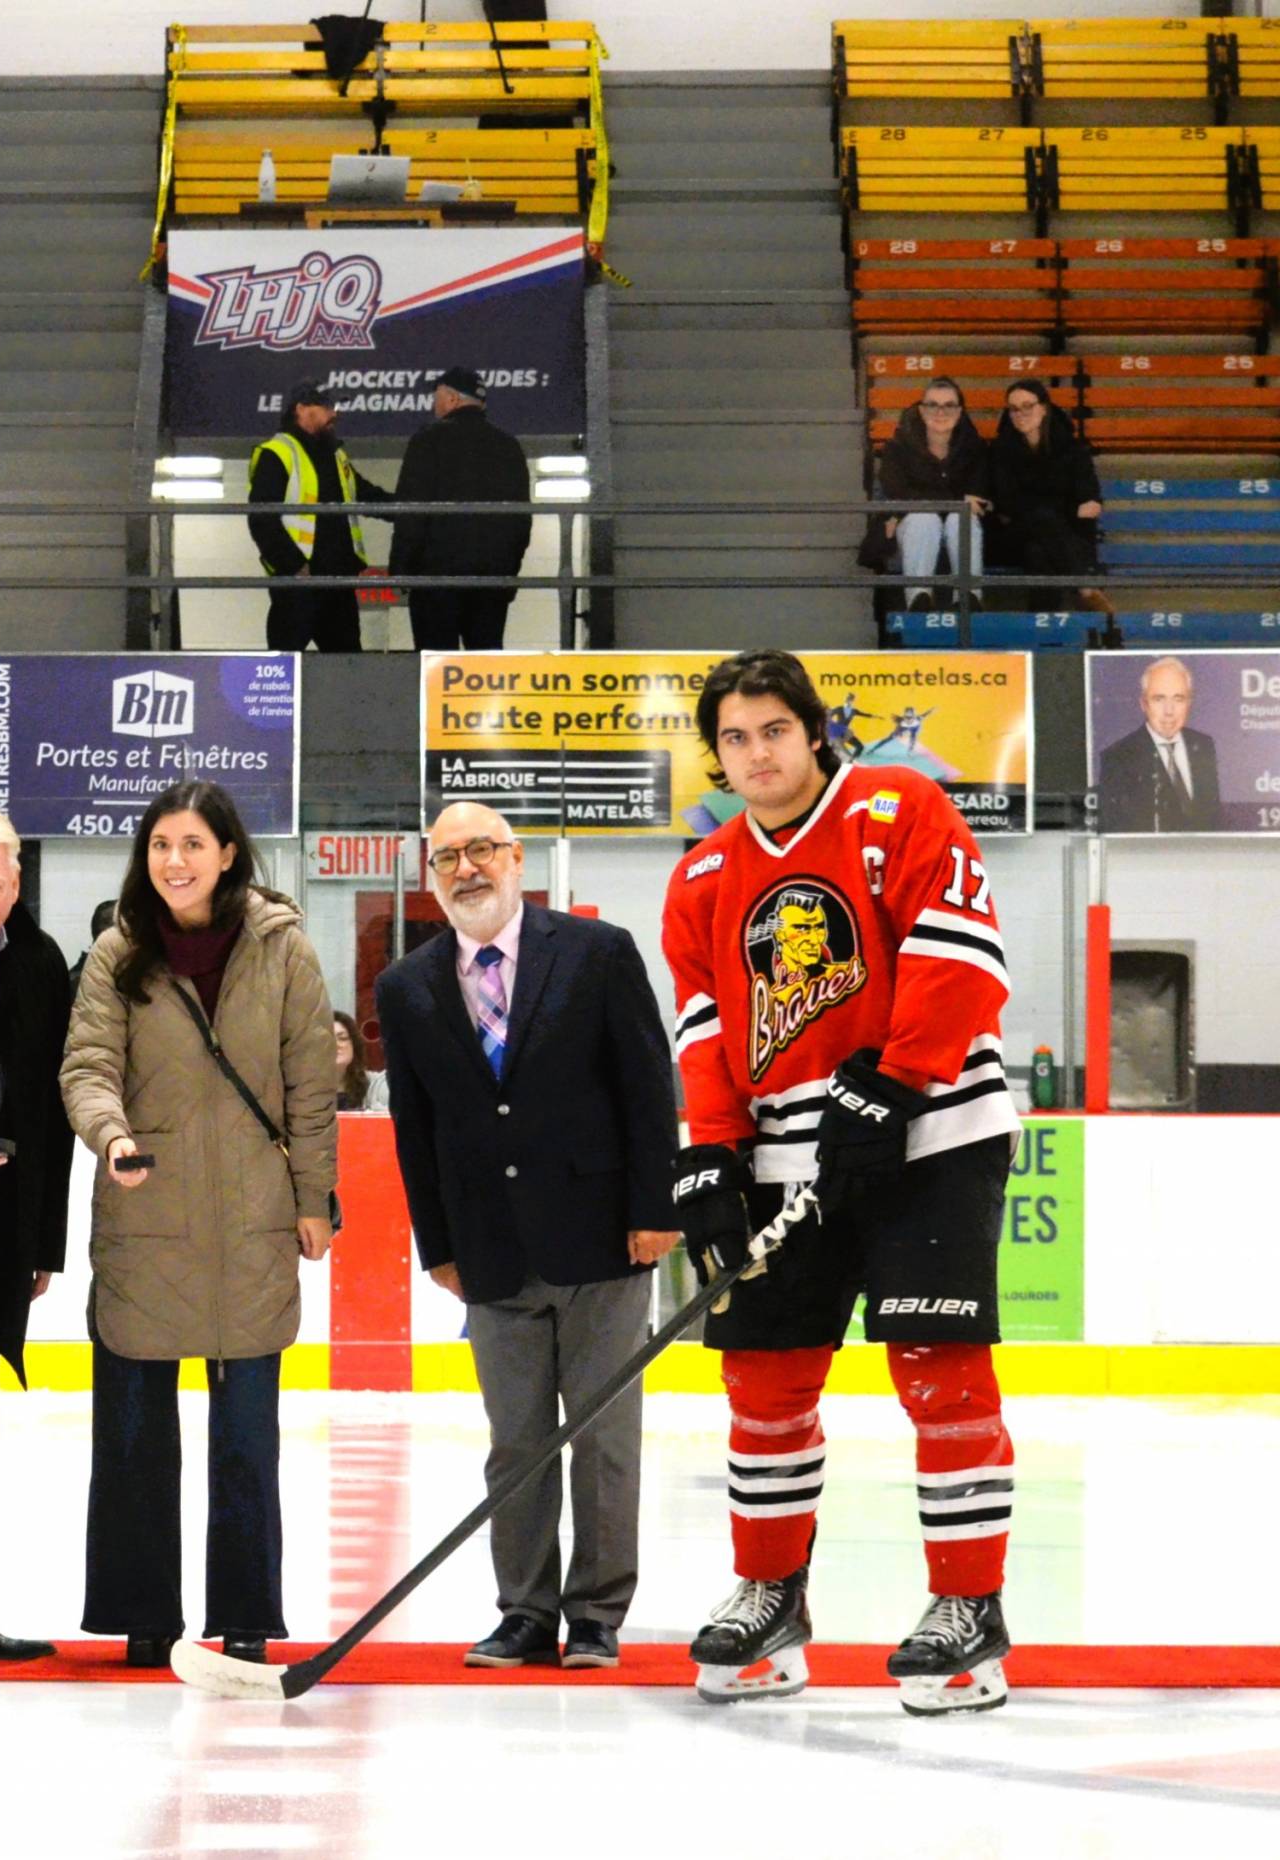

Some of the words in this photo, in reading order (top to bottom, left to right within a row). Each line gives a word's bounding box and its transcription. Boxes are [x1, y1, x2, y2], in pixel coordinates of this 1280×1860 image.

[426, 25, 436, 35] 2
[426, 131, 437, 143] 2
[880, 128, 906, 142] 28
[978, 128, 1004, 142] 27
[1081, 128, 1108, 142] 26
[1180, 127, 1207, 141] 25
[890, 240, 917, 255] 28
[990, 240, 1018, 254] 27
[1095, 239, 1123, 254] 26
[1197, 239, 1226, 253] 25
[905, 356, 934, 371] 28
[1009, 356, 1039, 371] 27
[1120, 356, 1151, 371] 26
[1223, 356, 1254, 371] 25
[328, 370, 420, 388] HOCKEY
[258, 395, 283, 412] LE
[334, 394, 434, 412] AGNAN
[1134, 480, 1165, 495] 26
[1239, 479, 1270, 494] 25
[926, 613, 956, 628] 28
[1035, 613, 1070, 628] 27
[1151, 613, 1182, 628] 26
[1260, 613, 1280, 627] 2
[256, 665, 286, 678] 10%
[442, 665, 521, 692] Pour
[530, 672, 571, 692] un
[820, 668, 1008, 687] monmatelas.ca
[248, 680, 261, 691] de
[1240, 669, 1280, 698] De
[259, 693, 295, 704] mentio
[248, 706, 260, 717] de
[441, 703, 542, 731] haute
[552, 704, 696, 736] perform
[36, 742, 118, 768] Portes
[125, 744, 151, 768] et
[159, 742, 269, 770] Fenêtres
[441, 757, 466, 773] LA
[441, 773, 536, 789] FABRIQUE
[1255, 770, 1280, 793] de
[629, 789, 655, 804] DE
[947, 793, 1009, 810] SARD
[568, 804, 655, 819] MATELAS
[66, 814, 113, 836] 450
[966, 816, 1009, 827] ereau
[862, 846, 885, 896] C
[944, 846, 991, 914] 17
[771, 964, 807, 992] Les
[750, 958, 868, 1082] Braves
[1001, 1195, 1058, 1244] ES
